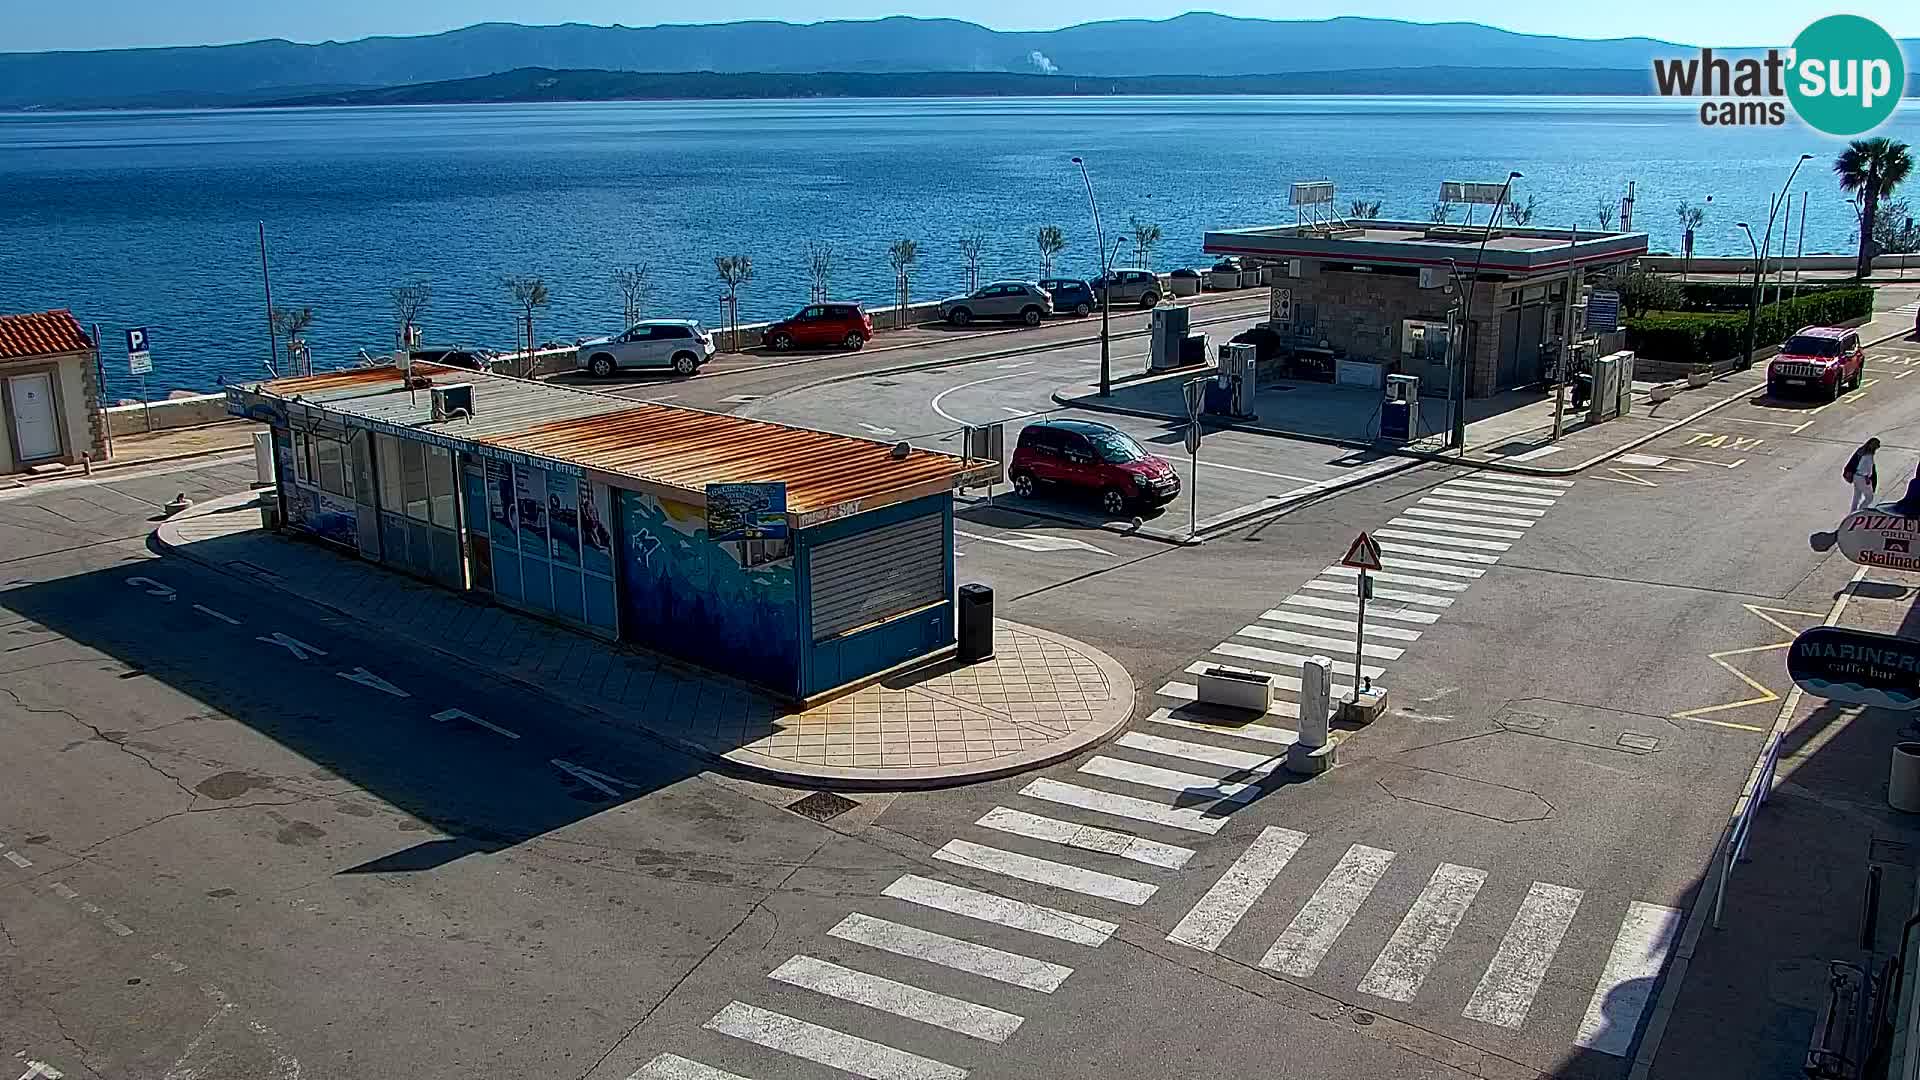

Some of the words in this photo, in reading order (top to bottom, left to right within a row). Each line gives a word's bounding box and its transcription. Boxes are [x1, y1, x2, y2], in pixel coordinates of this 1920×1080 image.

[130, 331, 143, 349] P
[1684, 432, 1764, 451] TAXI
[478, 445, 493, 457] BUS
[494, 449, 526, 465] STATION
[529, 457, 554, 471] TICKET
[555, 463, 583, 477] OFFICE
